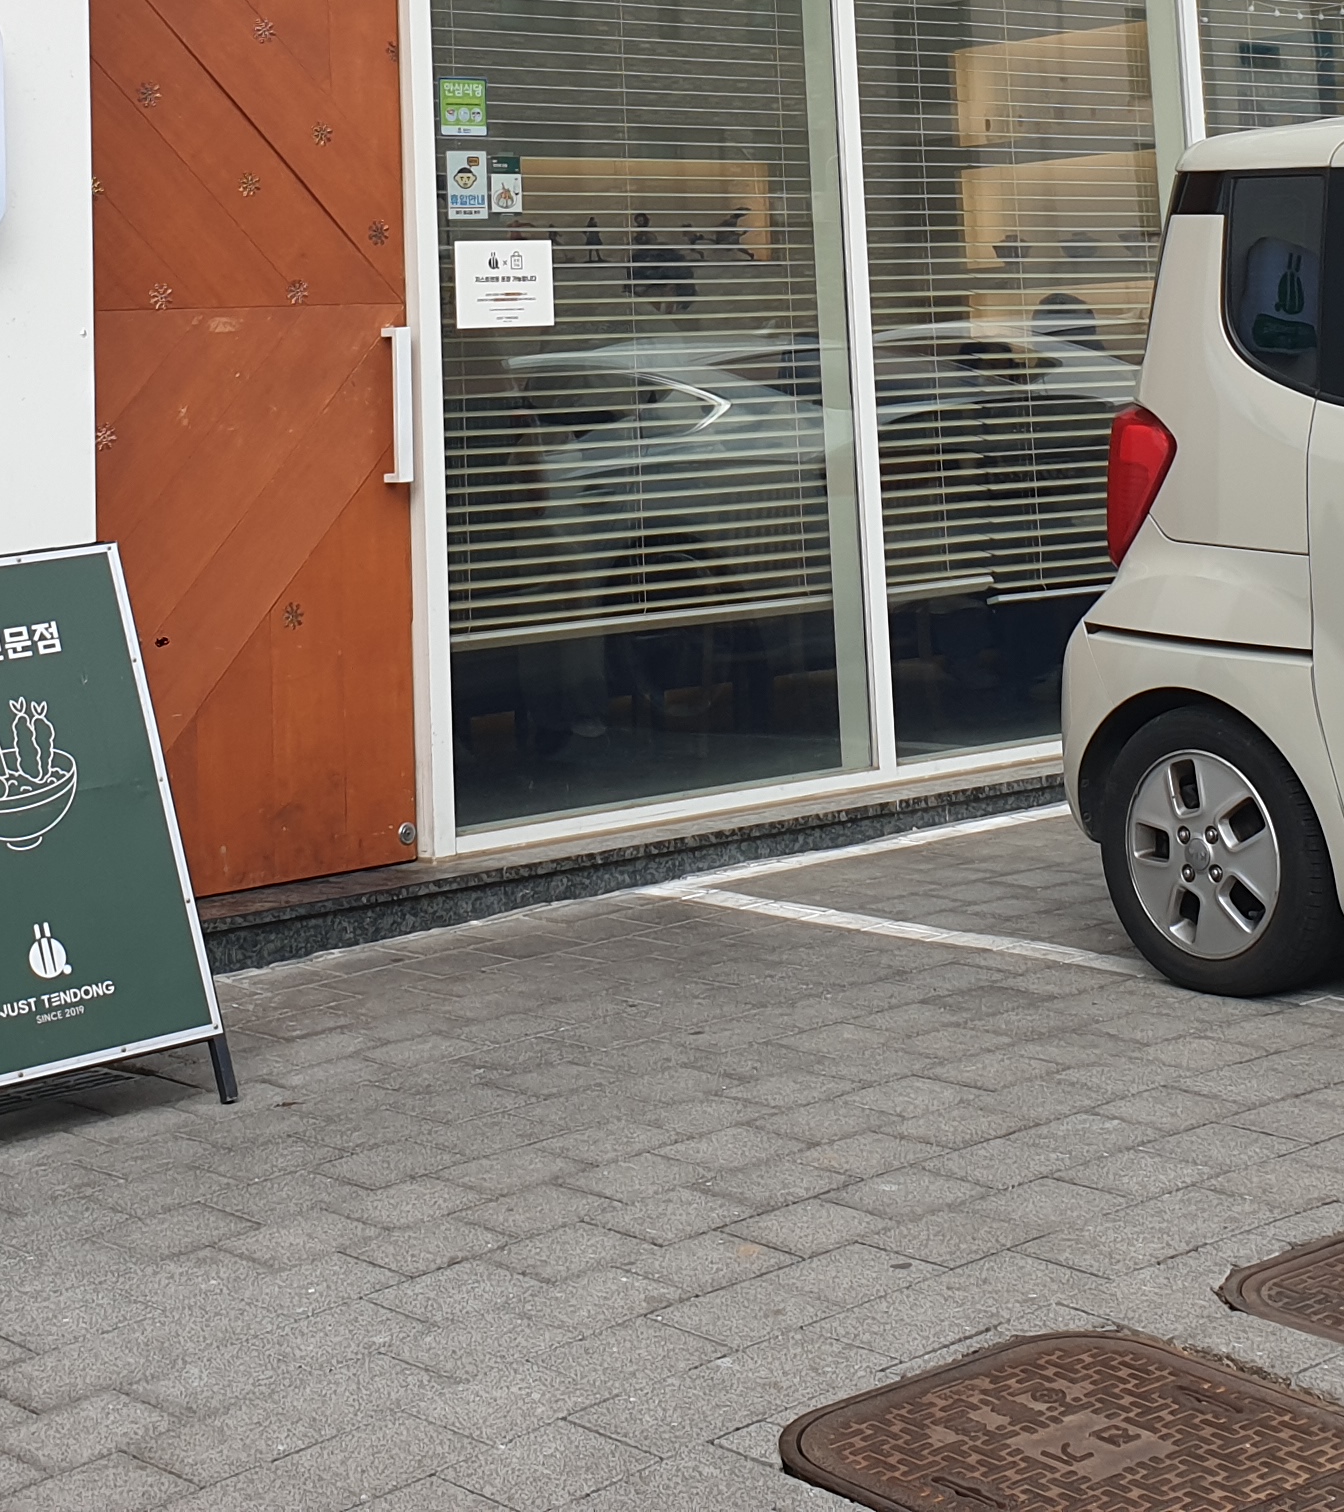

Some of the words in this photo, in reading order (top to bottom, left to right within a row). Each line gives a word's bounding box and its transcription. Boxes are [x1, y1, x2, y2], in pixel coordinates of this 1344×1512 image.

[443, 82, 483, 97] 안심식당
[0, 998, 37, 1018] JUST
[41, 981, 115, 1009] TENDONG
[36, 1010, 63, 1024] SINCE
[65, 1005, 85, 1018] 2019
